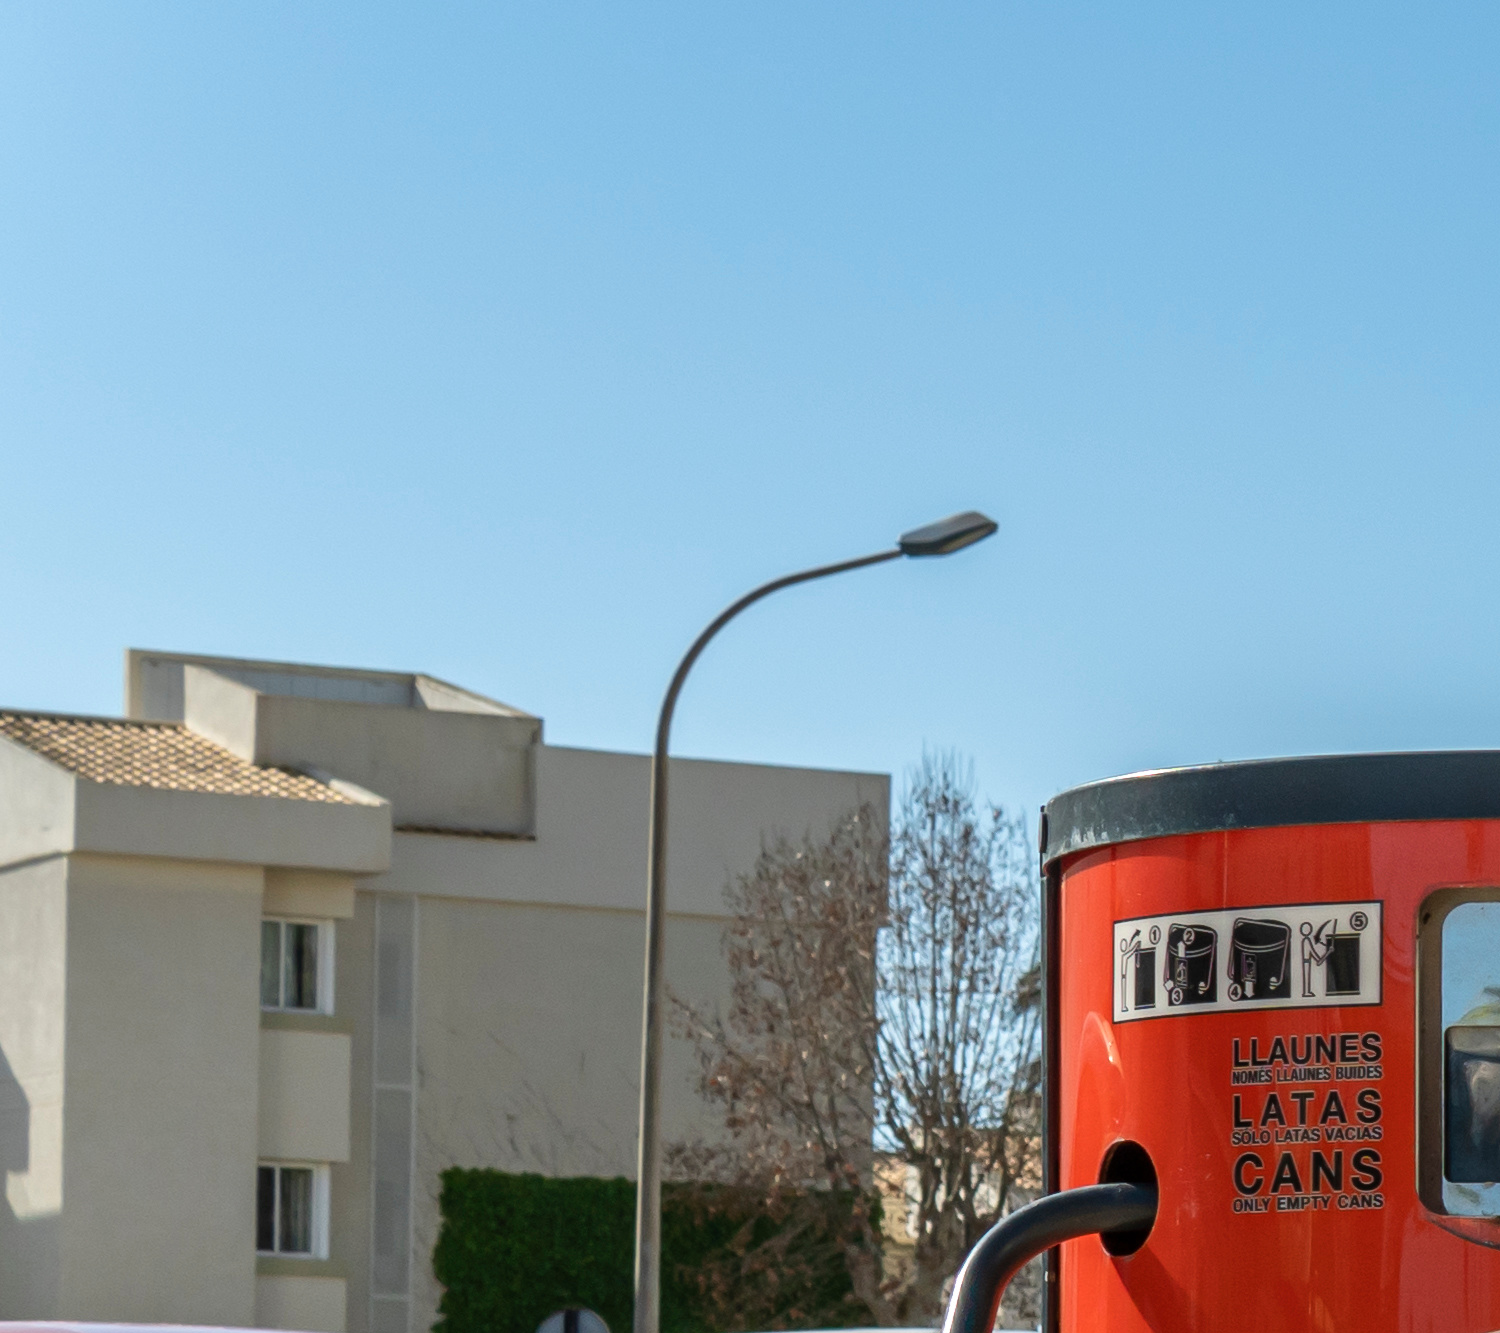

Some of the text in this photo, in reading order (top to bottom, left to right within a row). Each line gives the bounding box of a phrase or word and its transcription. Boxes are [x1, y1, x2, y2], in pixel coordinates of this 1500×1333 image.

[1232, 1032, 1382, 1068] LLAUNES
[1232, 1065, 1383, 1085] NOMÉS LLAUNES BUIDES
[1232, 1088, 1382, 1129] LATAS
[1232, 1127, 1271, 1146] SÓLO
[1274, 1127, 1321, 1143] LATAS
[1232, 1147, 1383, 1197] CANS
[1232, 1193, 1384, 1214] ONLY EMPTY CANS
